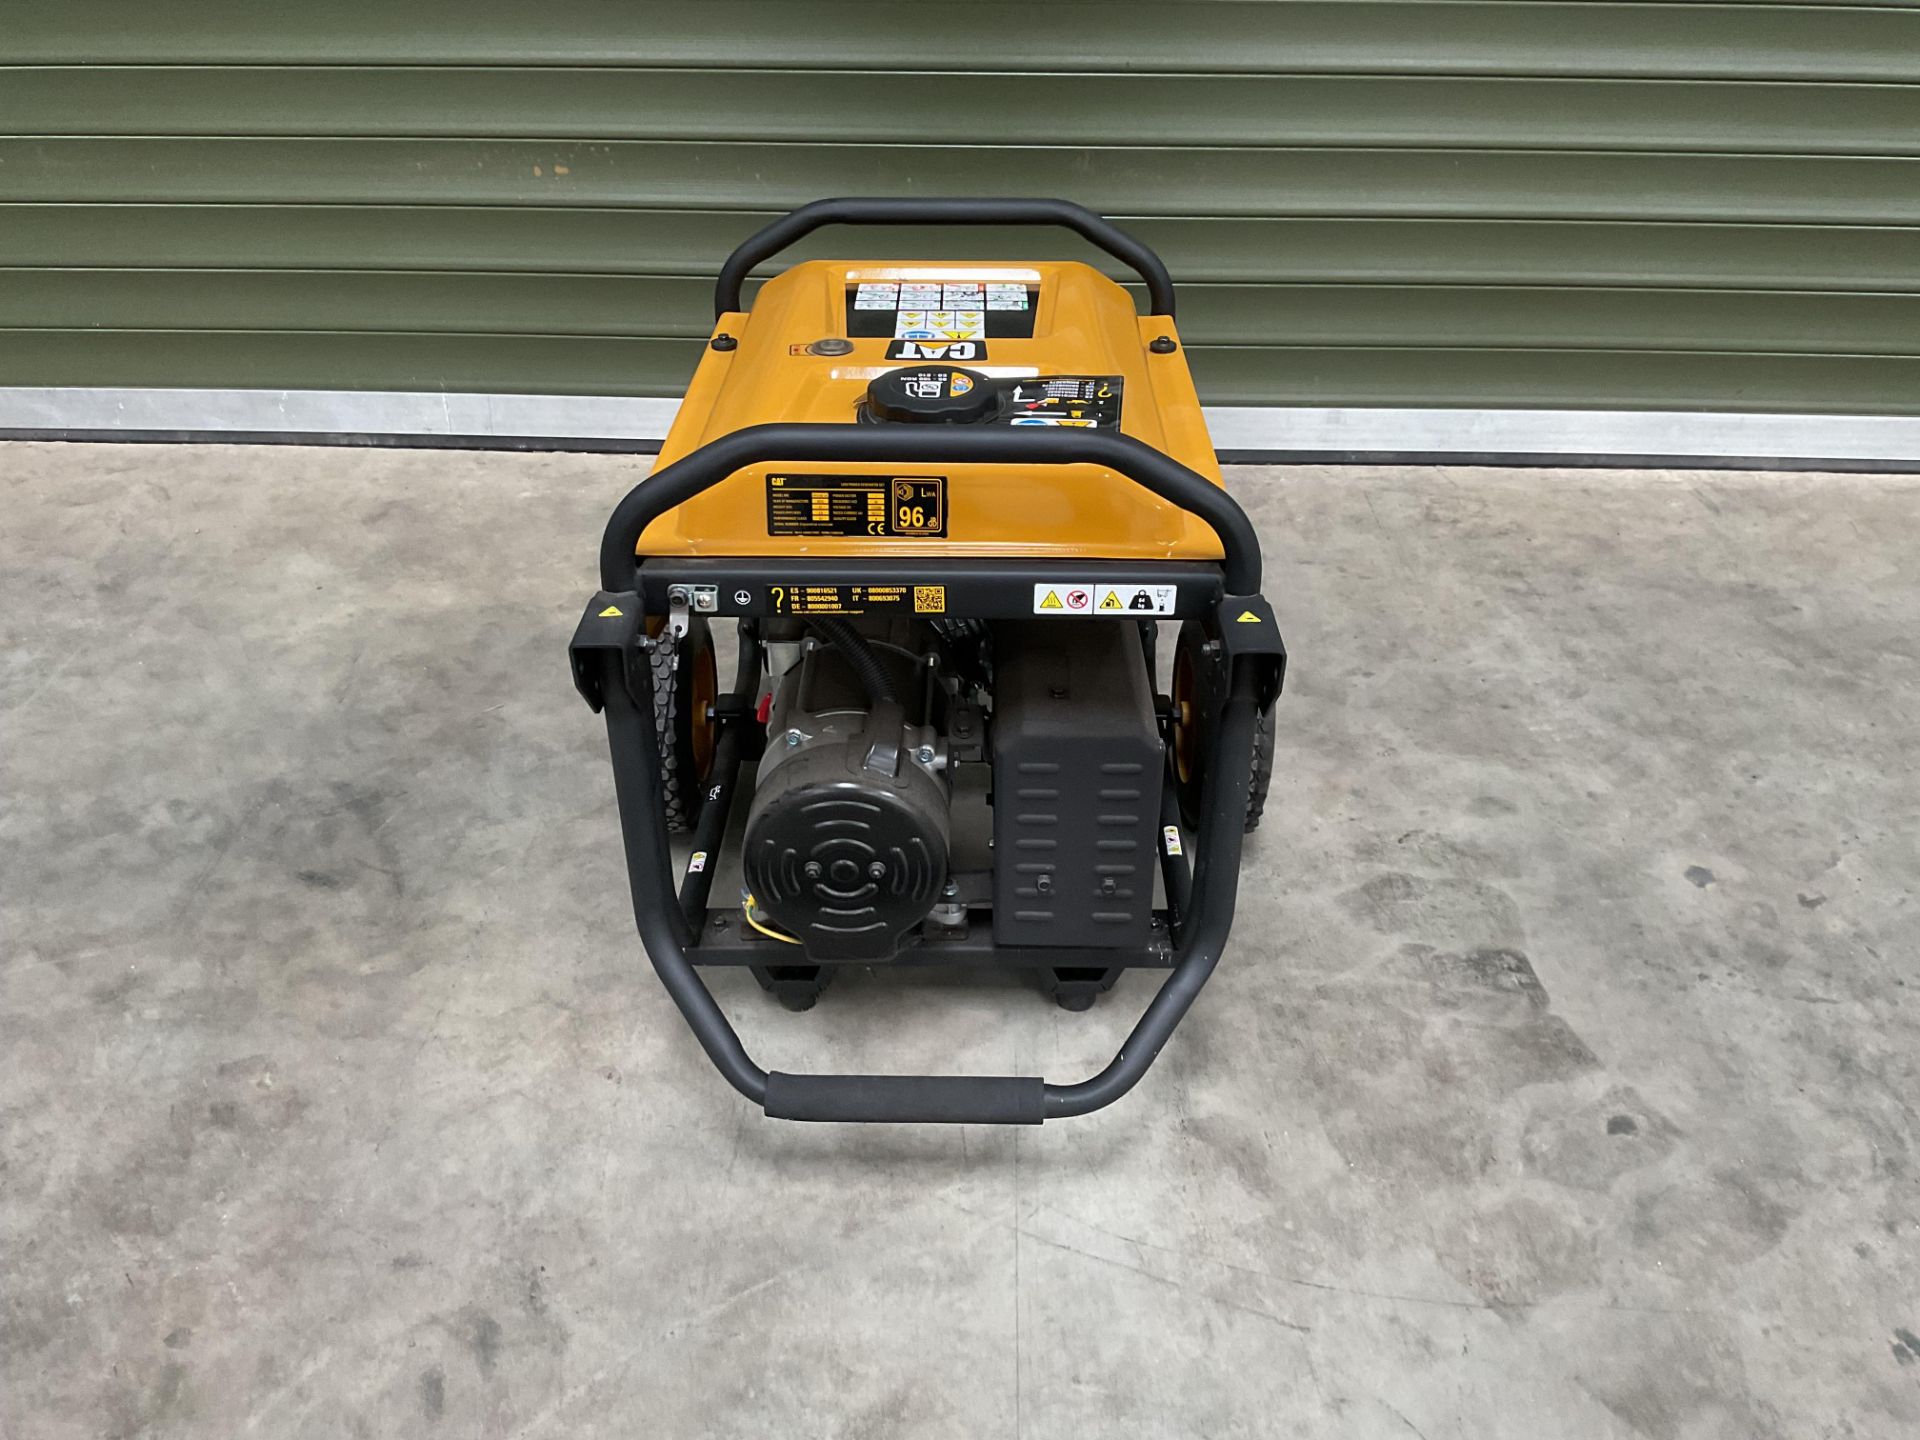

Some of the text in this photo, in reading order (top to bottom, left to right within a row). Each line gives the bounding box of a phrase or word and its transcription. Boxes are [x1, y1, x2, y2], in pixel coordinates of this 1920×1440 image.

[895, 341, 976, 359] CAT
[771, 477, 784, 486] CAT
[899, 506, 924, 527] 96
